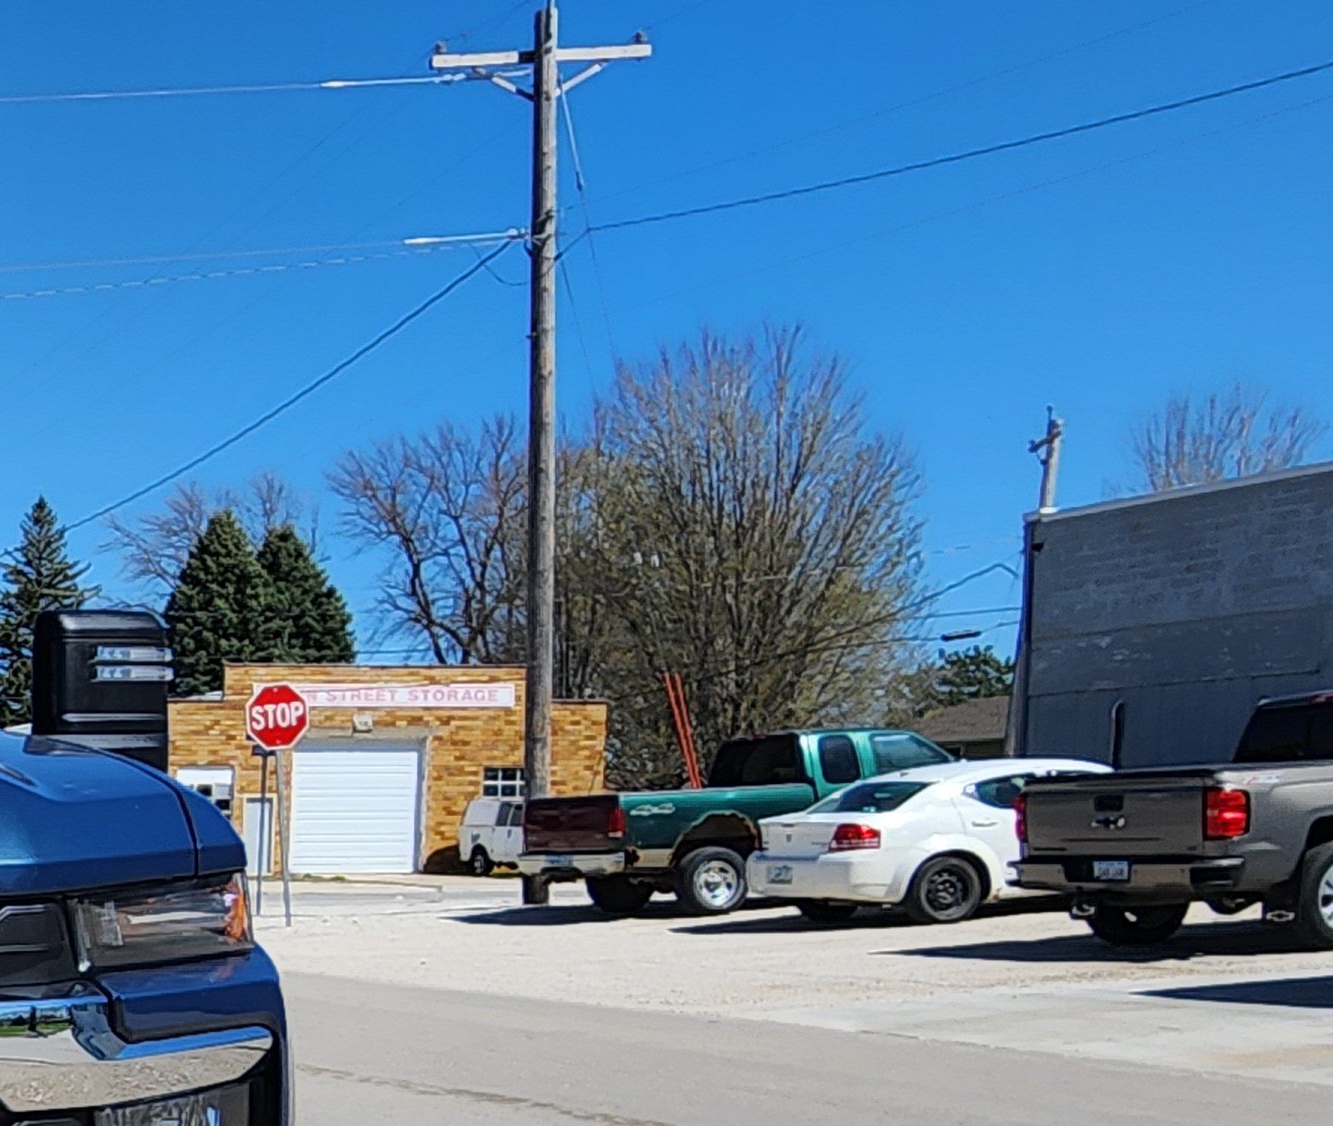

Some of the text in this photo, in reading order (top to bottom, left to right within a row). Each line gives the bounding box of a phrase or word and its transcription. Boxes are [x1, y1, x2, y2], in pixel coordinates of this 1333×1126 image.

[325, 688, 398, 702] STREET
[407, 688, 499, 702] STORAGE
[250, 701, 304, 731] STOP
